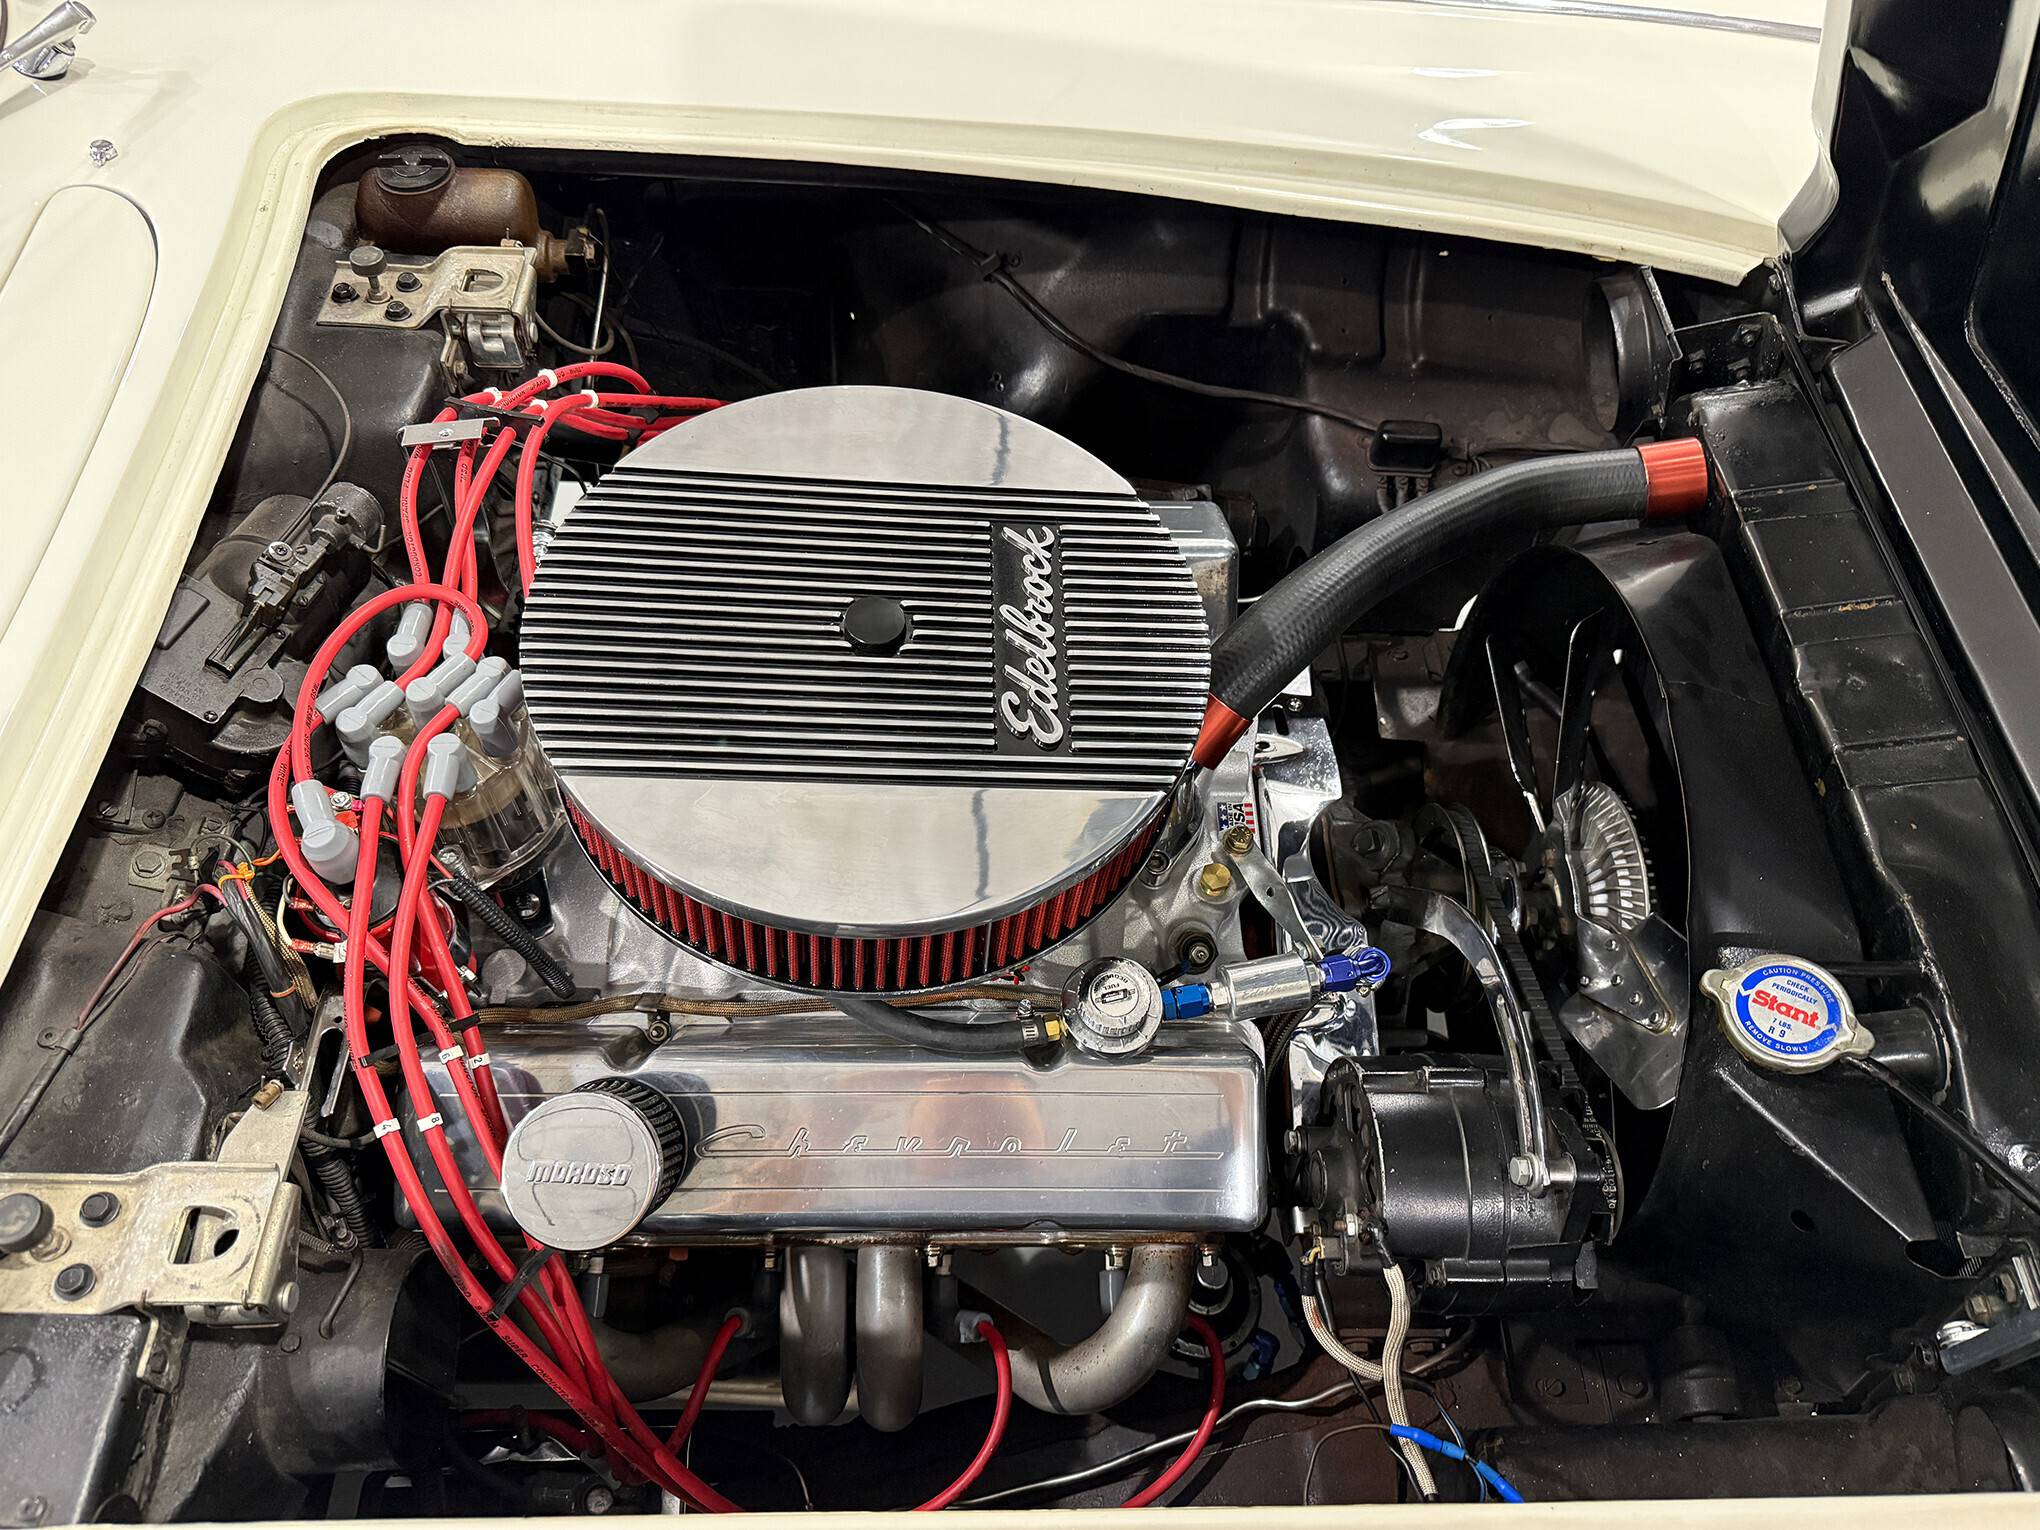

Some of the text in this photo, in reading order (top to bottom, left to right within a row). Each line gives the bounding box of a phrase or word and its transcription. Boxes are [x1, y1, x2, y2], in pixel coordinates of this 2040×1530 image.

[999, 525, 1064, 745] Edelbrock
[1103, 983, 1120, 991] FUEL
[1762, 967, 1835, 1004] CAUTION PRESSURE
[1771, 982, 1818, 1006] PERIODICALLY
[1786, 979, 1810, 993] CHECK
[1751, 989, 1820, 1029] Stant
[1744, 1020, 1809, 1053] REMOVE SLOWLY
[1778, 1020, 1793, 1031] LBS.
[1778, 1030, 1786, 1039] 9
[473, 1056, 484, 1065] 2
[431, 1116, 440, 1124] 8
[693, 1123, 1226, 1159] Chevrolet
[525, 1160, 634, 1187] MOROSO
[501, 1334, 529, 1359] SUPER
